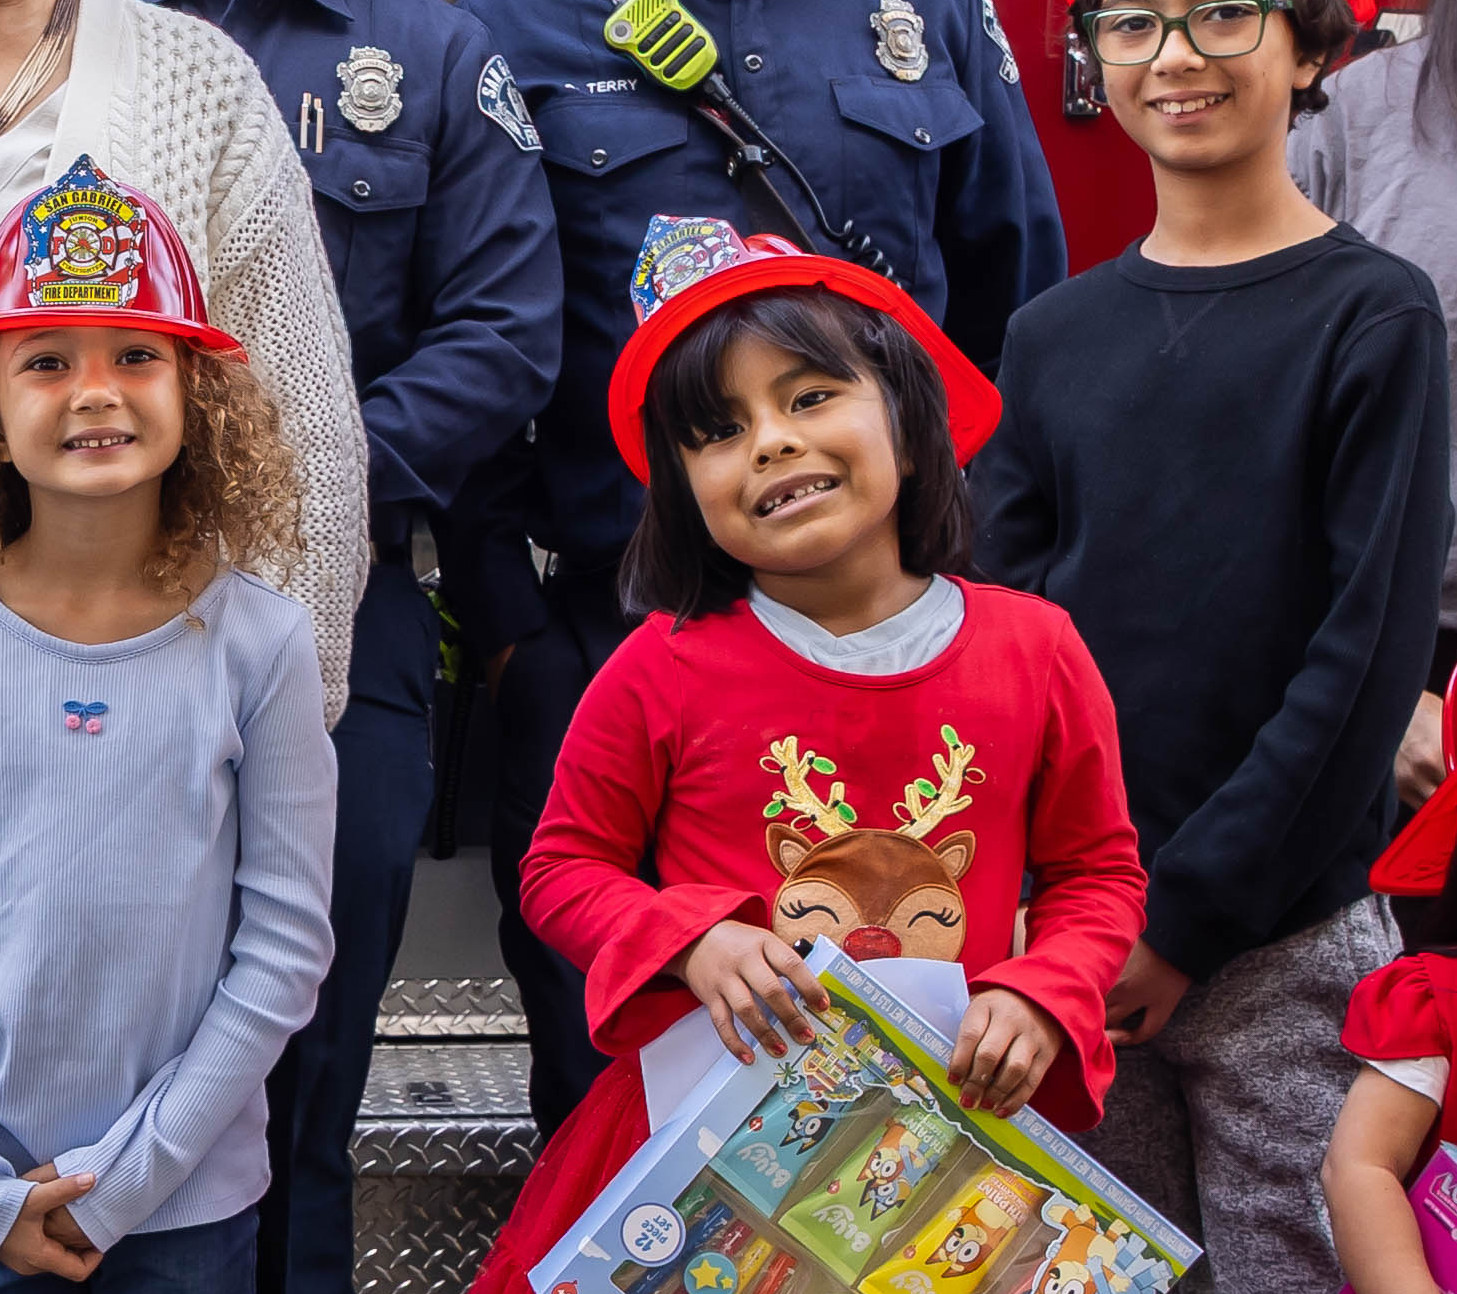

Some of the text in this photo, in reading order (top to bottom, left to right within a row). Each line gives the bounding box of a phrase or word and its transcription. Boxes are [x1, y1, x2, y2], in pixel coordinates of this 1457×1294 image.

[586, 79, 638, 94] TERRY
[44, 190, 123, 214] SAN GABRIEL
[68, 215, 99, 225] JUNIOR
[51, 236, 115, 254] F D
[61, 261, 106, 276] FIREFIGHTER
[44, 286, 117, 301] FIRE DEPARTMENT
[734, 1141, 791, 1189] BLUEY
[638, 1217, 670, 1245] PIECE
[651, 1212, 673, 1233] SET
[810, 1203, 872, 1253] BLUEY
[632, 1229, 656, 1253] 12
